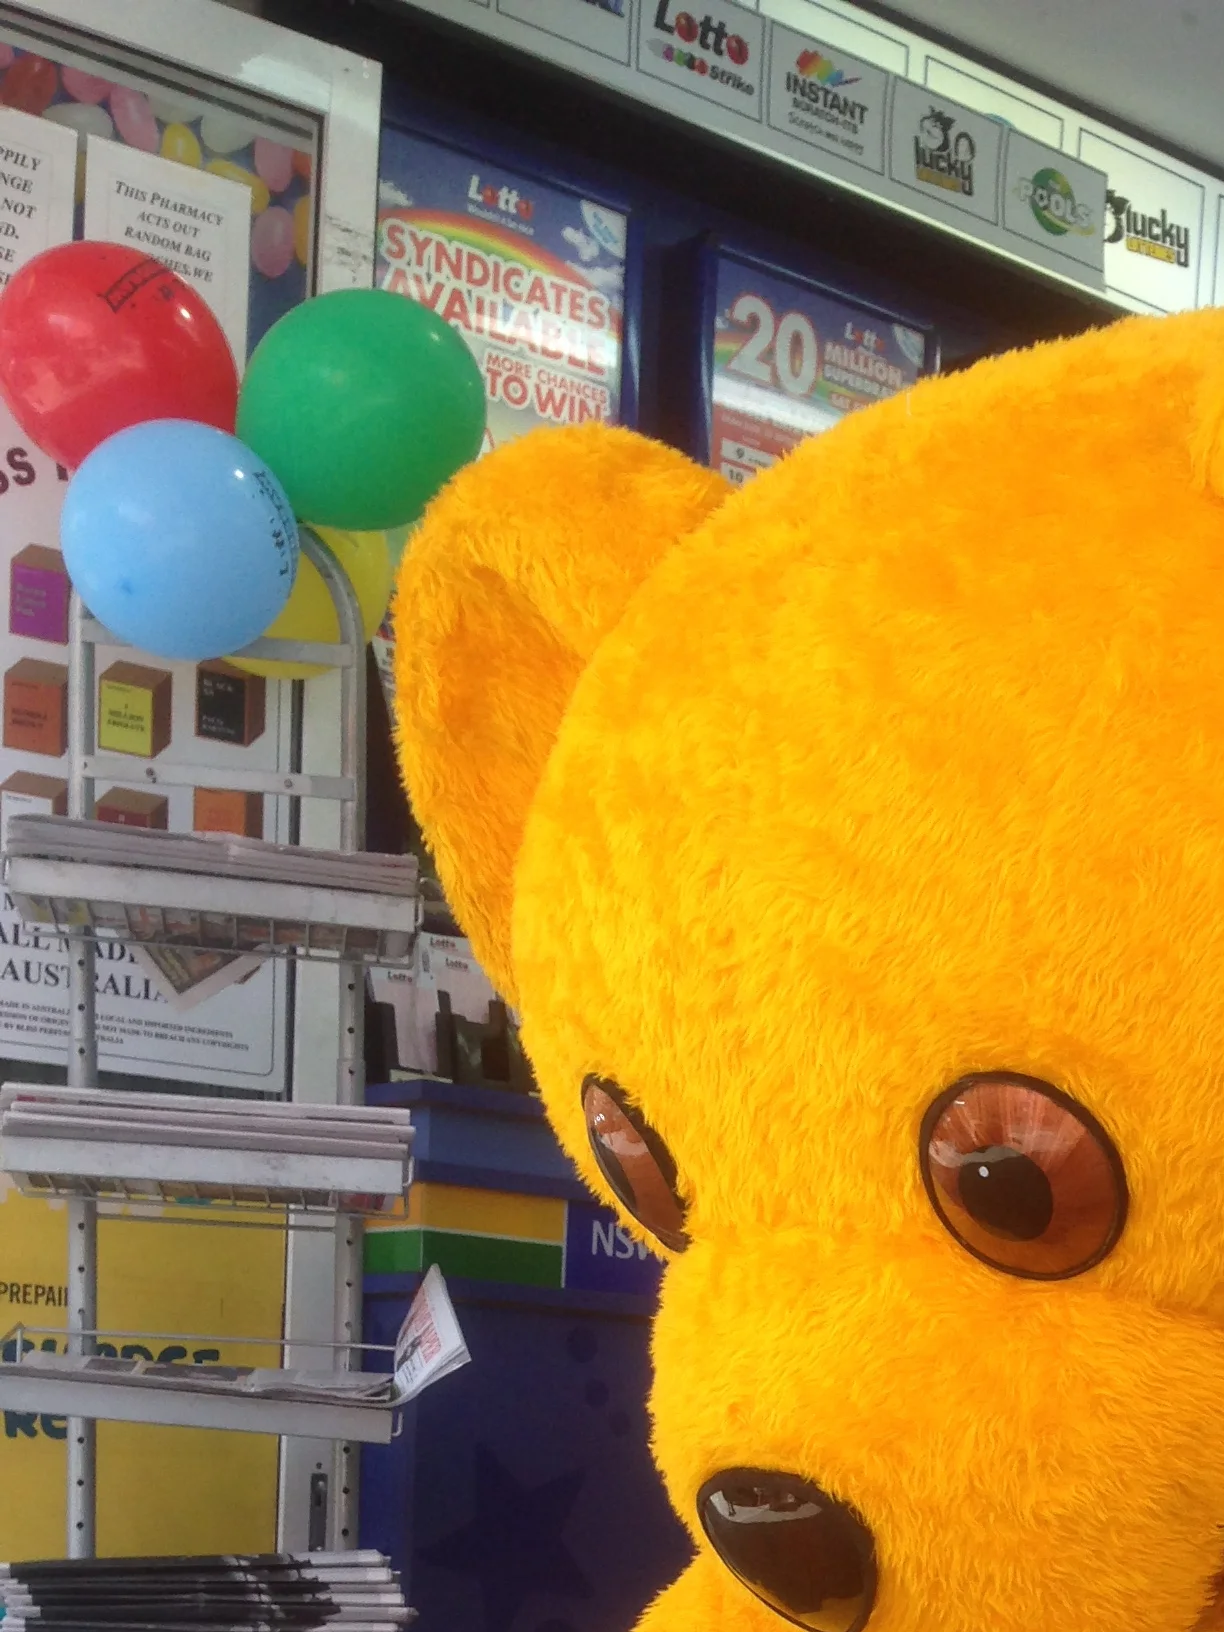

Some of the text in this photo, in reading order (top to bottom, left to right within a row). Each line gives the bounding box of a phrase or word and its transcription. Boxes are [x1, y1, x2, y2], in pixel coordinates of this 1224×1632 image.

[654, 0, 749, 66] Lotto
[785, 71, 869, 124] INSTANT
[914, 135, 975, 196] lucky
[115, 180, 148, 202] THIS
[467, 174, 535, 221] Lotto
[0, 220, 20, 240] D.
[124, 225, 212, 263] RANDOM BAG
[137, 210, 201, 239] ACTS OUT
[1126, 202, 1190, 269] lucky
[384, 223, 606, 331] SYNDICATES
[728, 293, 818, 398] 20
[843, 321, 886, 354] Lotto
[486, 351, 608, 405] MORE CHANCES
[487, 367, 529, 408] TO
[1, 957, 170, 1005] AUSTALI
[591, 1219, 652, 1261] NS
[0, 1281, 69, 1307] PREPAI
